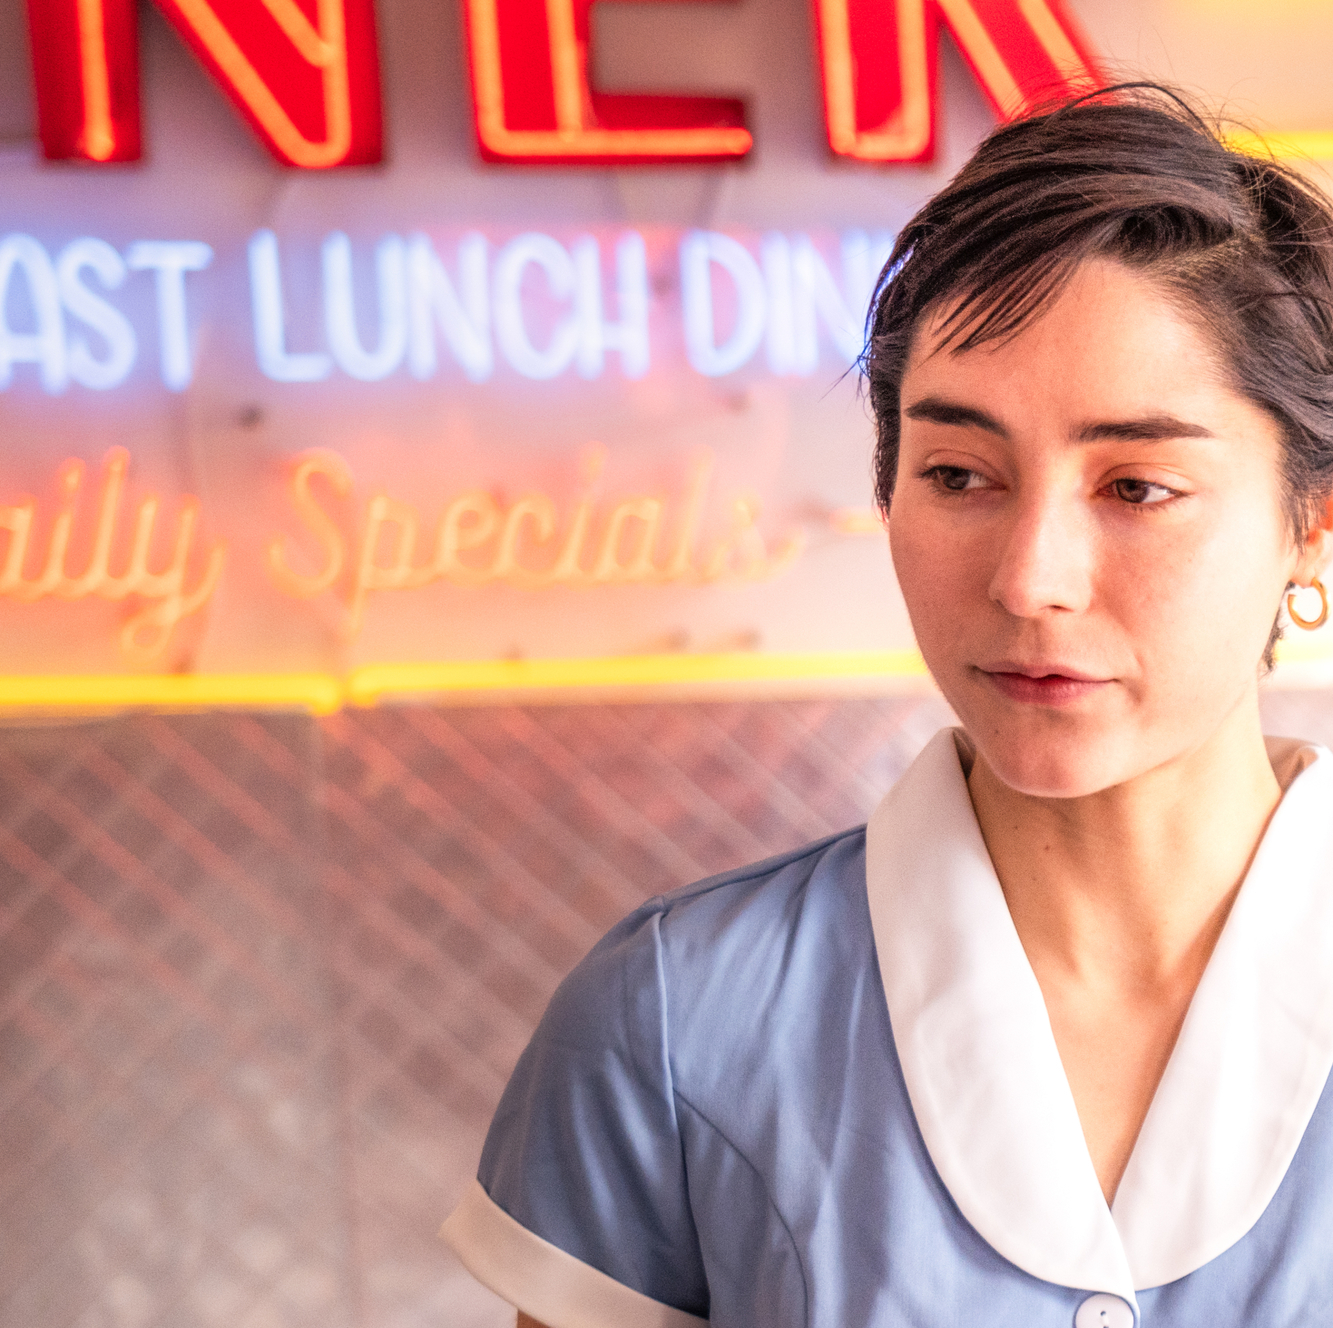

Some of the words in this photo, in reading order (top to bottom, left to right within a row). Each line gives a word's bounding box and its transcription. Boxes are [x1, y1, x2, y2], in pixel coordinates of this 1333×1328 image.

[247, 228, 650, 382] LUNCH
[680, 229, 898, 378] DIN
[268, 447, 798, 638] Specials
